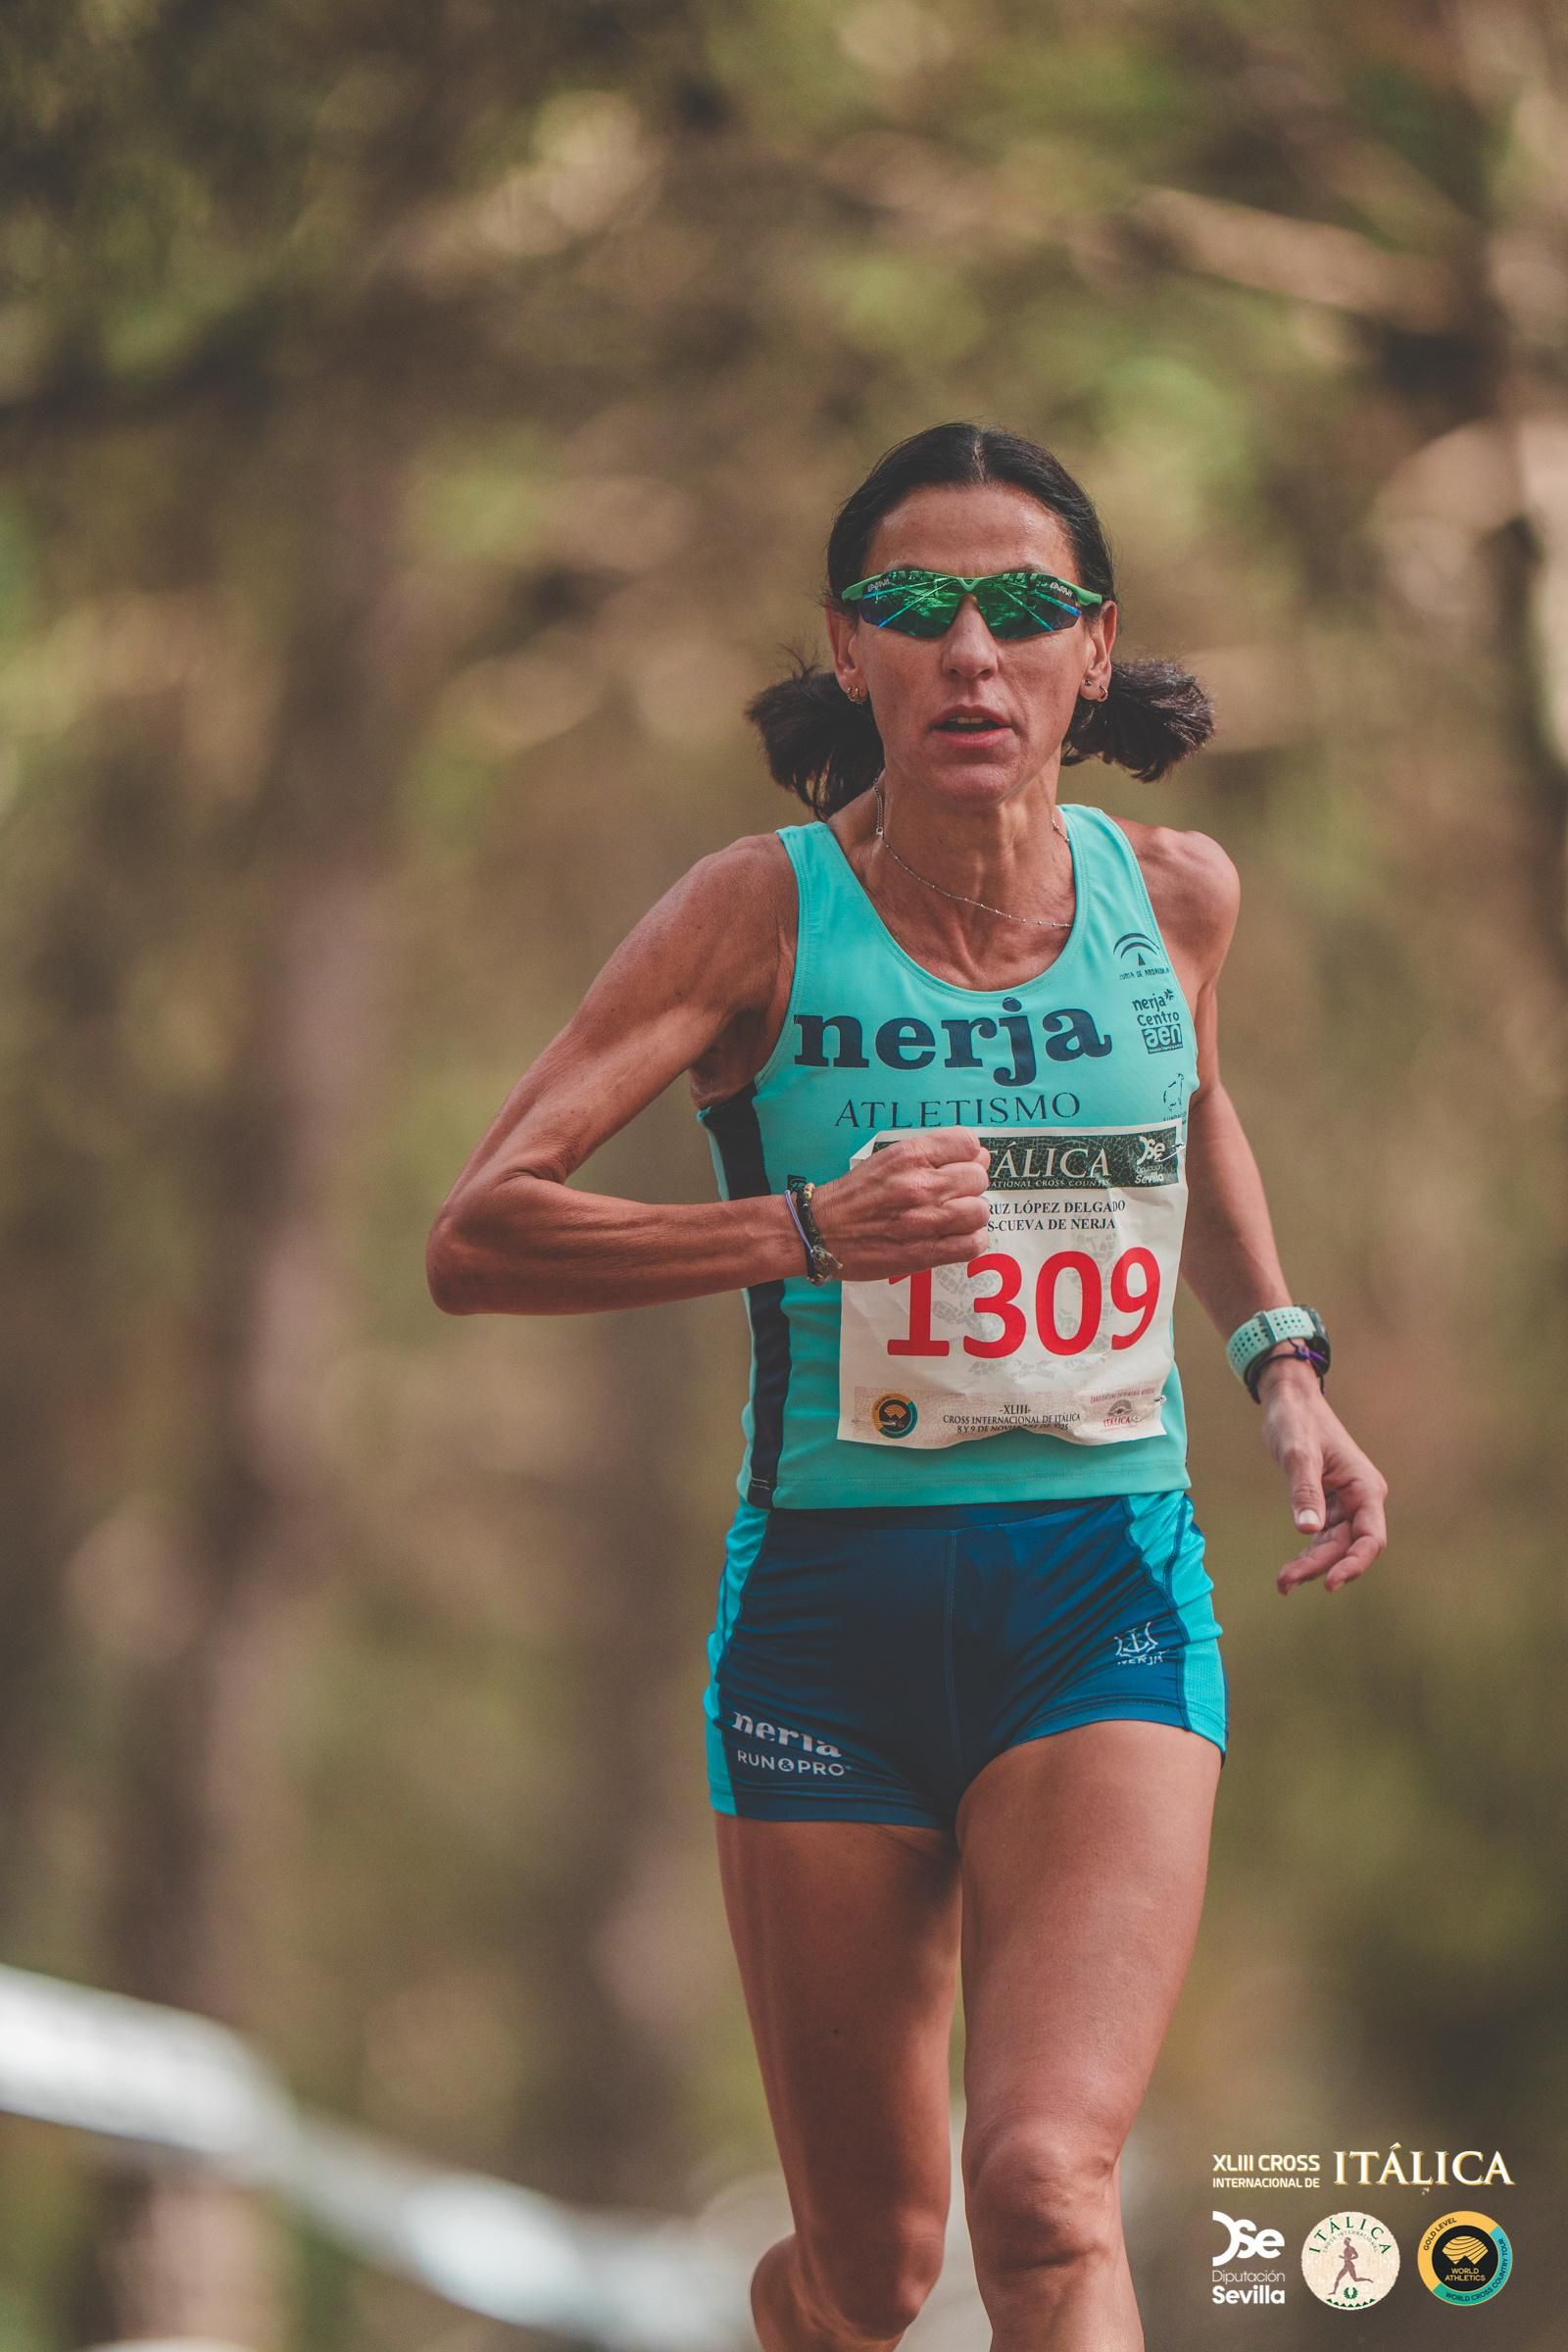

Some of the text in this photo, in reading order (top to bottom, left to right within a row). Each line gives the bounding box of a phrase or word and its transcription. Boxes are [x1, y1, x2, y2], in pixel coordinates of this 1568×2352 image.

[1132, 993, 1166, 1011] nerja
[1137, 1011, 1180, 1026] Centro
[794, 997, 1112, 1087] nerja
[1144, 1025, 1182, 1049] aen
[835, 1092, 1080, 1129] ATLETISMO
[988, 1142, 1112, 1179] ÁLICA
[989, 1180, 1031, 1189] ATIONAL
[1035, 1179, 1065, 1188] CROSS
[988, 1200, 1125, 1215] RUZ LÓPEZ DELGADO
[987, 1217, 1115, 1232] S-CUEVA DE NERJA
[887, 1246, 1161, 1358] 1309
[943, 1414, 969, 1424] CROSS
[972, 1413, 1040, 1425] INTERNACIONAL
